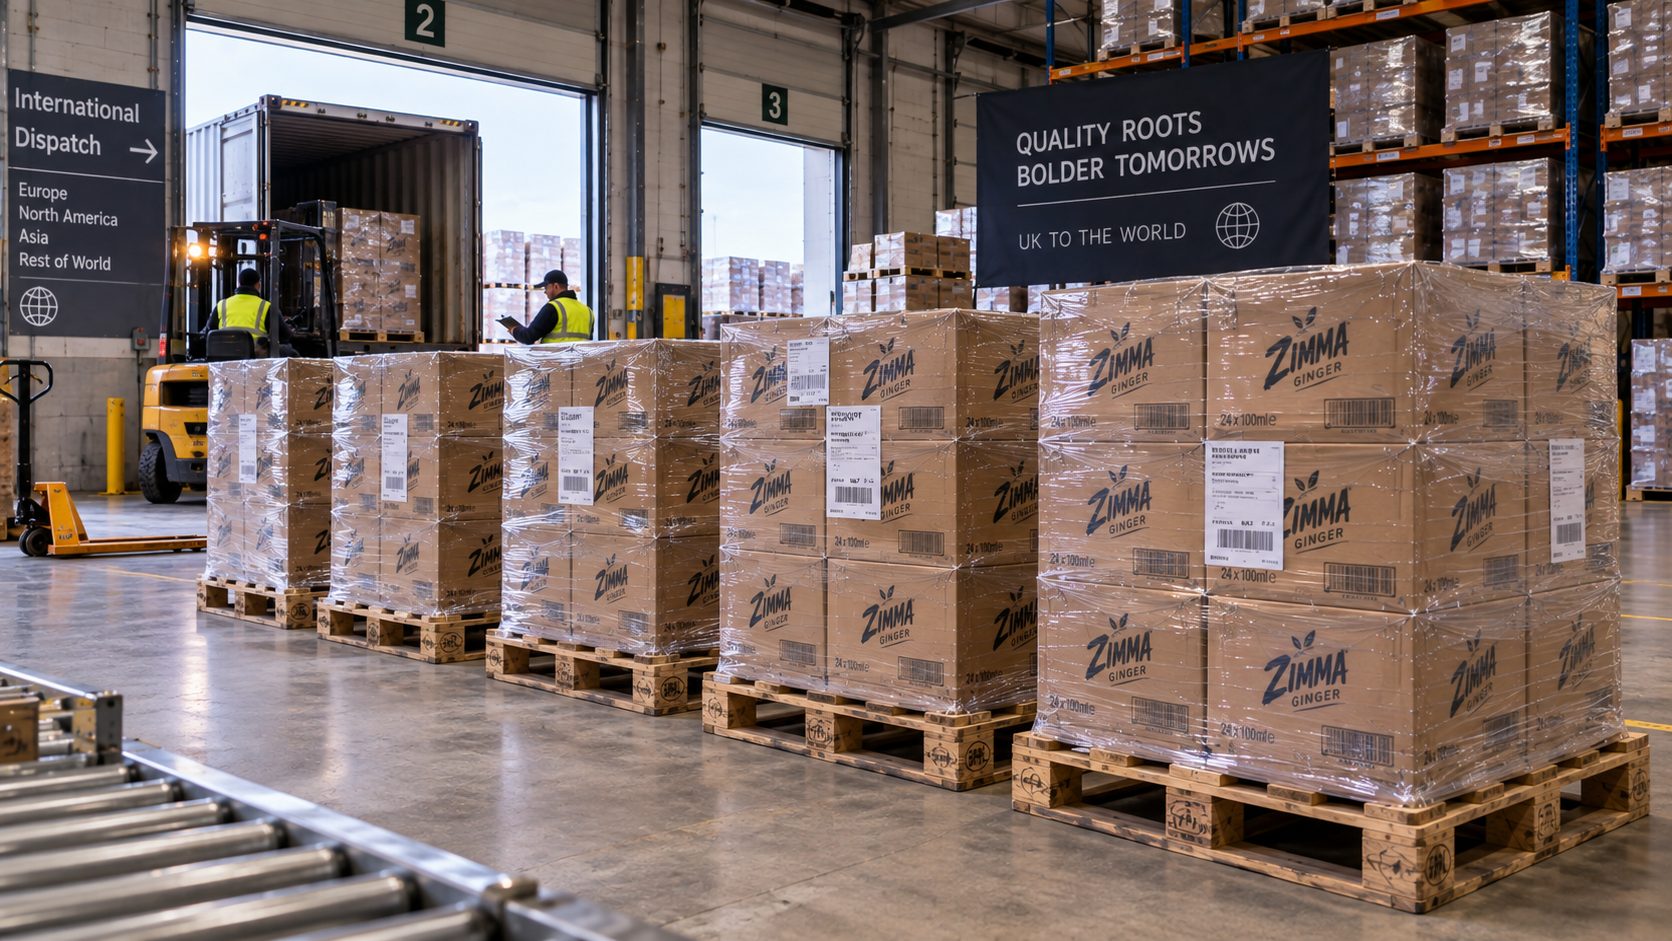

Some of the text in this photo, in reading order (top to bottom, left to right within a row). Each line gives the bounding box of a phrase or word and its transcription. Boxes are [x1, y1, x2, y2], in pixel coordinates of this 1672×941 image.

[416, 4, 435, 38] 2
[15, 87, 140, 124] International
[768, 91, 782, 119] 3
[15, 126, 101, 156] Dispatch
[1016, 111, 1202, 156] QUALITY ROOTS
[1017, 137, 1276, 187] BOLDER TOMORROWS
[19, 182, 68, 202] Europe
[19, 205, 118, 227] North America
[19, 229, 49, 244] Asia
[1019, 222, 1186, 250] UK TO THE WORLD
[19, 252, 111, 271] Rest of World
[1088, 336, 1155, 397] ZIMMA
[1264, 321, 1350, 391] ZIMMA
[1293, 361, 1342, 387] GINGER
[1451, 328, 1497, 389] ZIMMA
[751, 361, 788, 404] ZIMM
[861, 349, 915, 401] ZIMMA
[1111, 372, 1149, 395] GINGER
[594, 463, 629, 503] ZIMMA
[750, 469, 792, 515] ZIMMA
[880, 472, 915, 507] IMMA
[1085, 480, 1153, 536] ZIMMA
[1108, 515, 1146, 534] GINGER
[1451, 483, 1497, 552] ZIMMA
[1294, 527, 1344, 550] GINGER
[594, 564, 629, 601] ZIMMA
[750, 587, 792, 629] ZIMMA
[861, 598, 915, 644] ZIMMA
[879, 628, 910, 645] GINGER
[1085, 631, 1153, 681] ZIMMA
[1108, 665, 1146, 683] GINGER
[1262, 649, 1349, 706] ZIMMA
[1450, 645, 1497, 719] ZIMMA
[1291, 688, 1341, 708] GINGER
